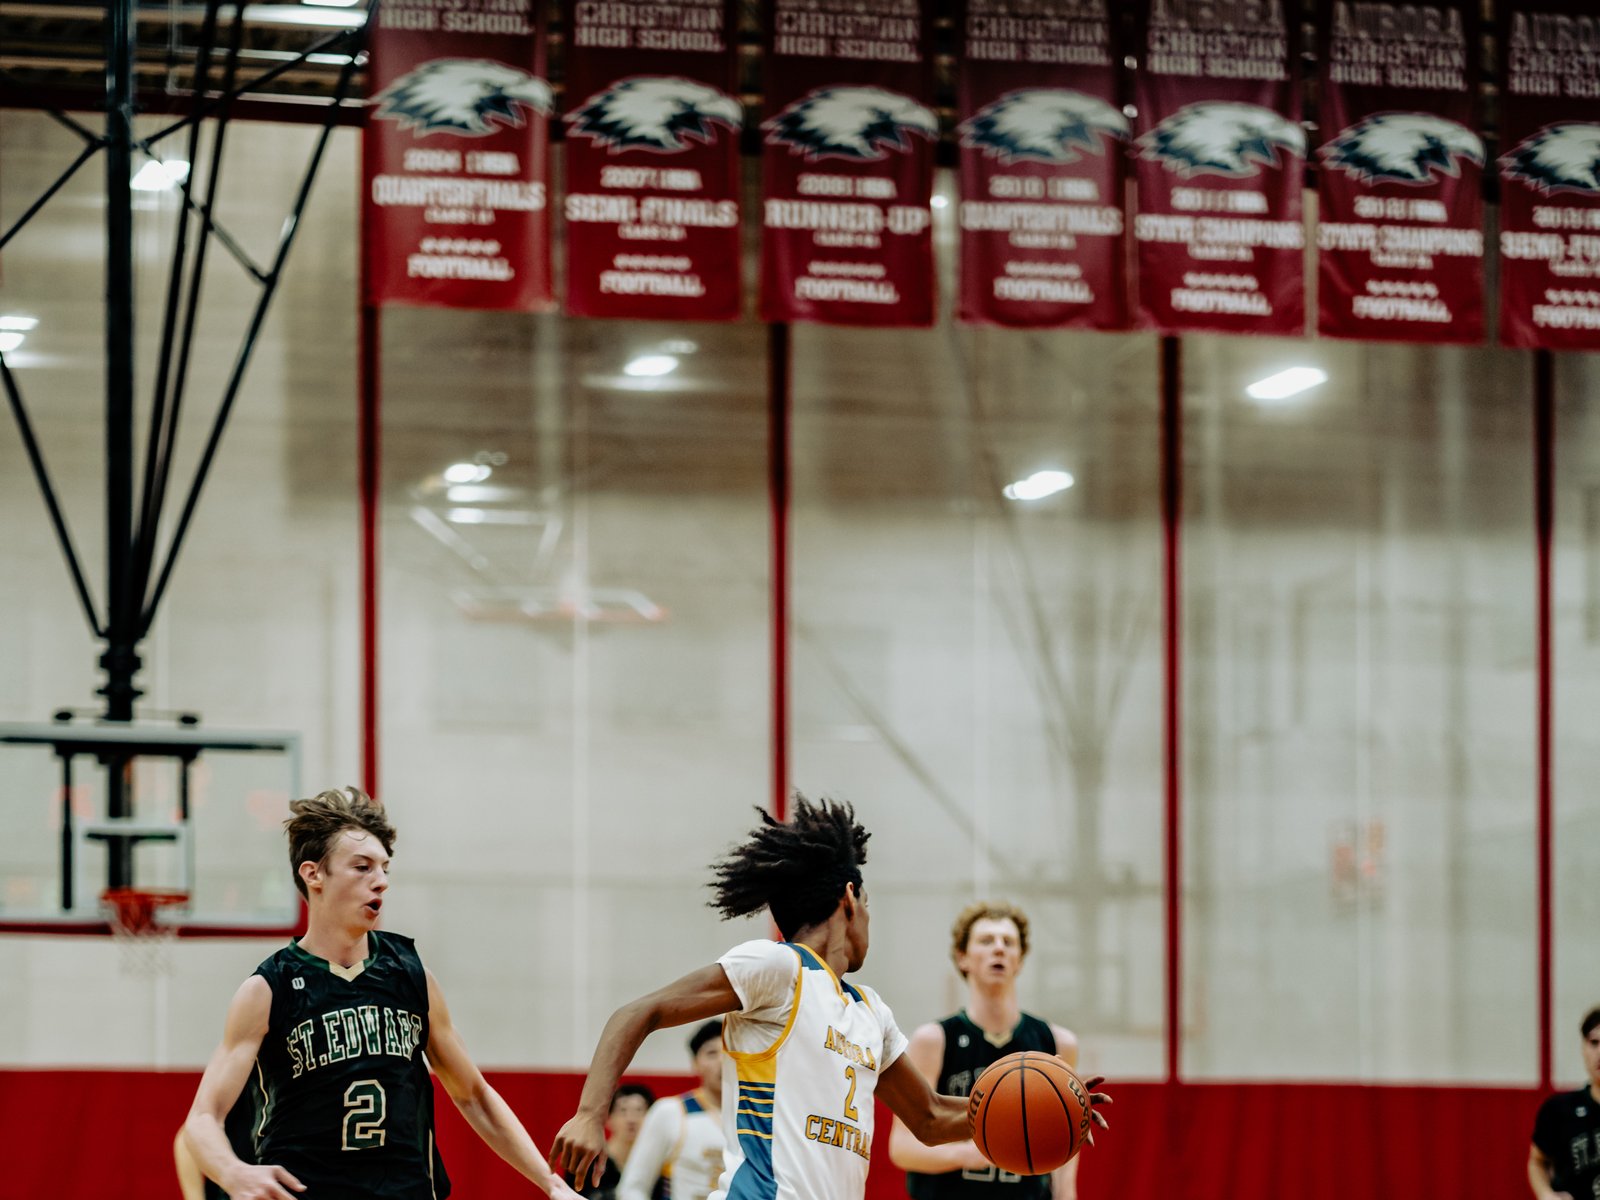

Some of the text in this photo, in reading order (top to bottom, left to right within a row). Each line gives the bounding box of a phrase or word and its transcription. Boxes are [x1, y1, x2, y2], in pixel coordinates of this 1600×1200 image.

[441, 11, 534, 35] SCHOOL
[635, 29, 726, 53] SCHOOL
[600, 270, 706, 297] FOOTBALL
[795, 276, 900, 304] FOOTBALL
[844, 1065, 859, 1123] 2
[341, 1079, 387, 1151] 2
